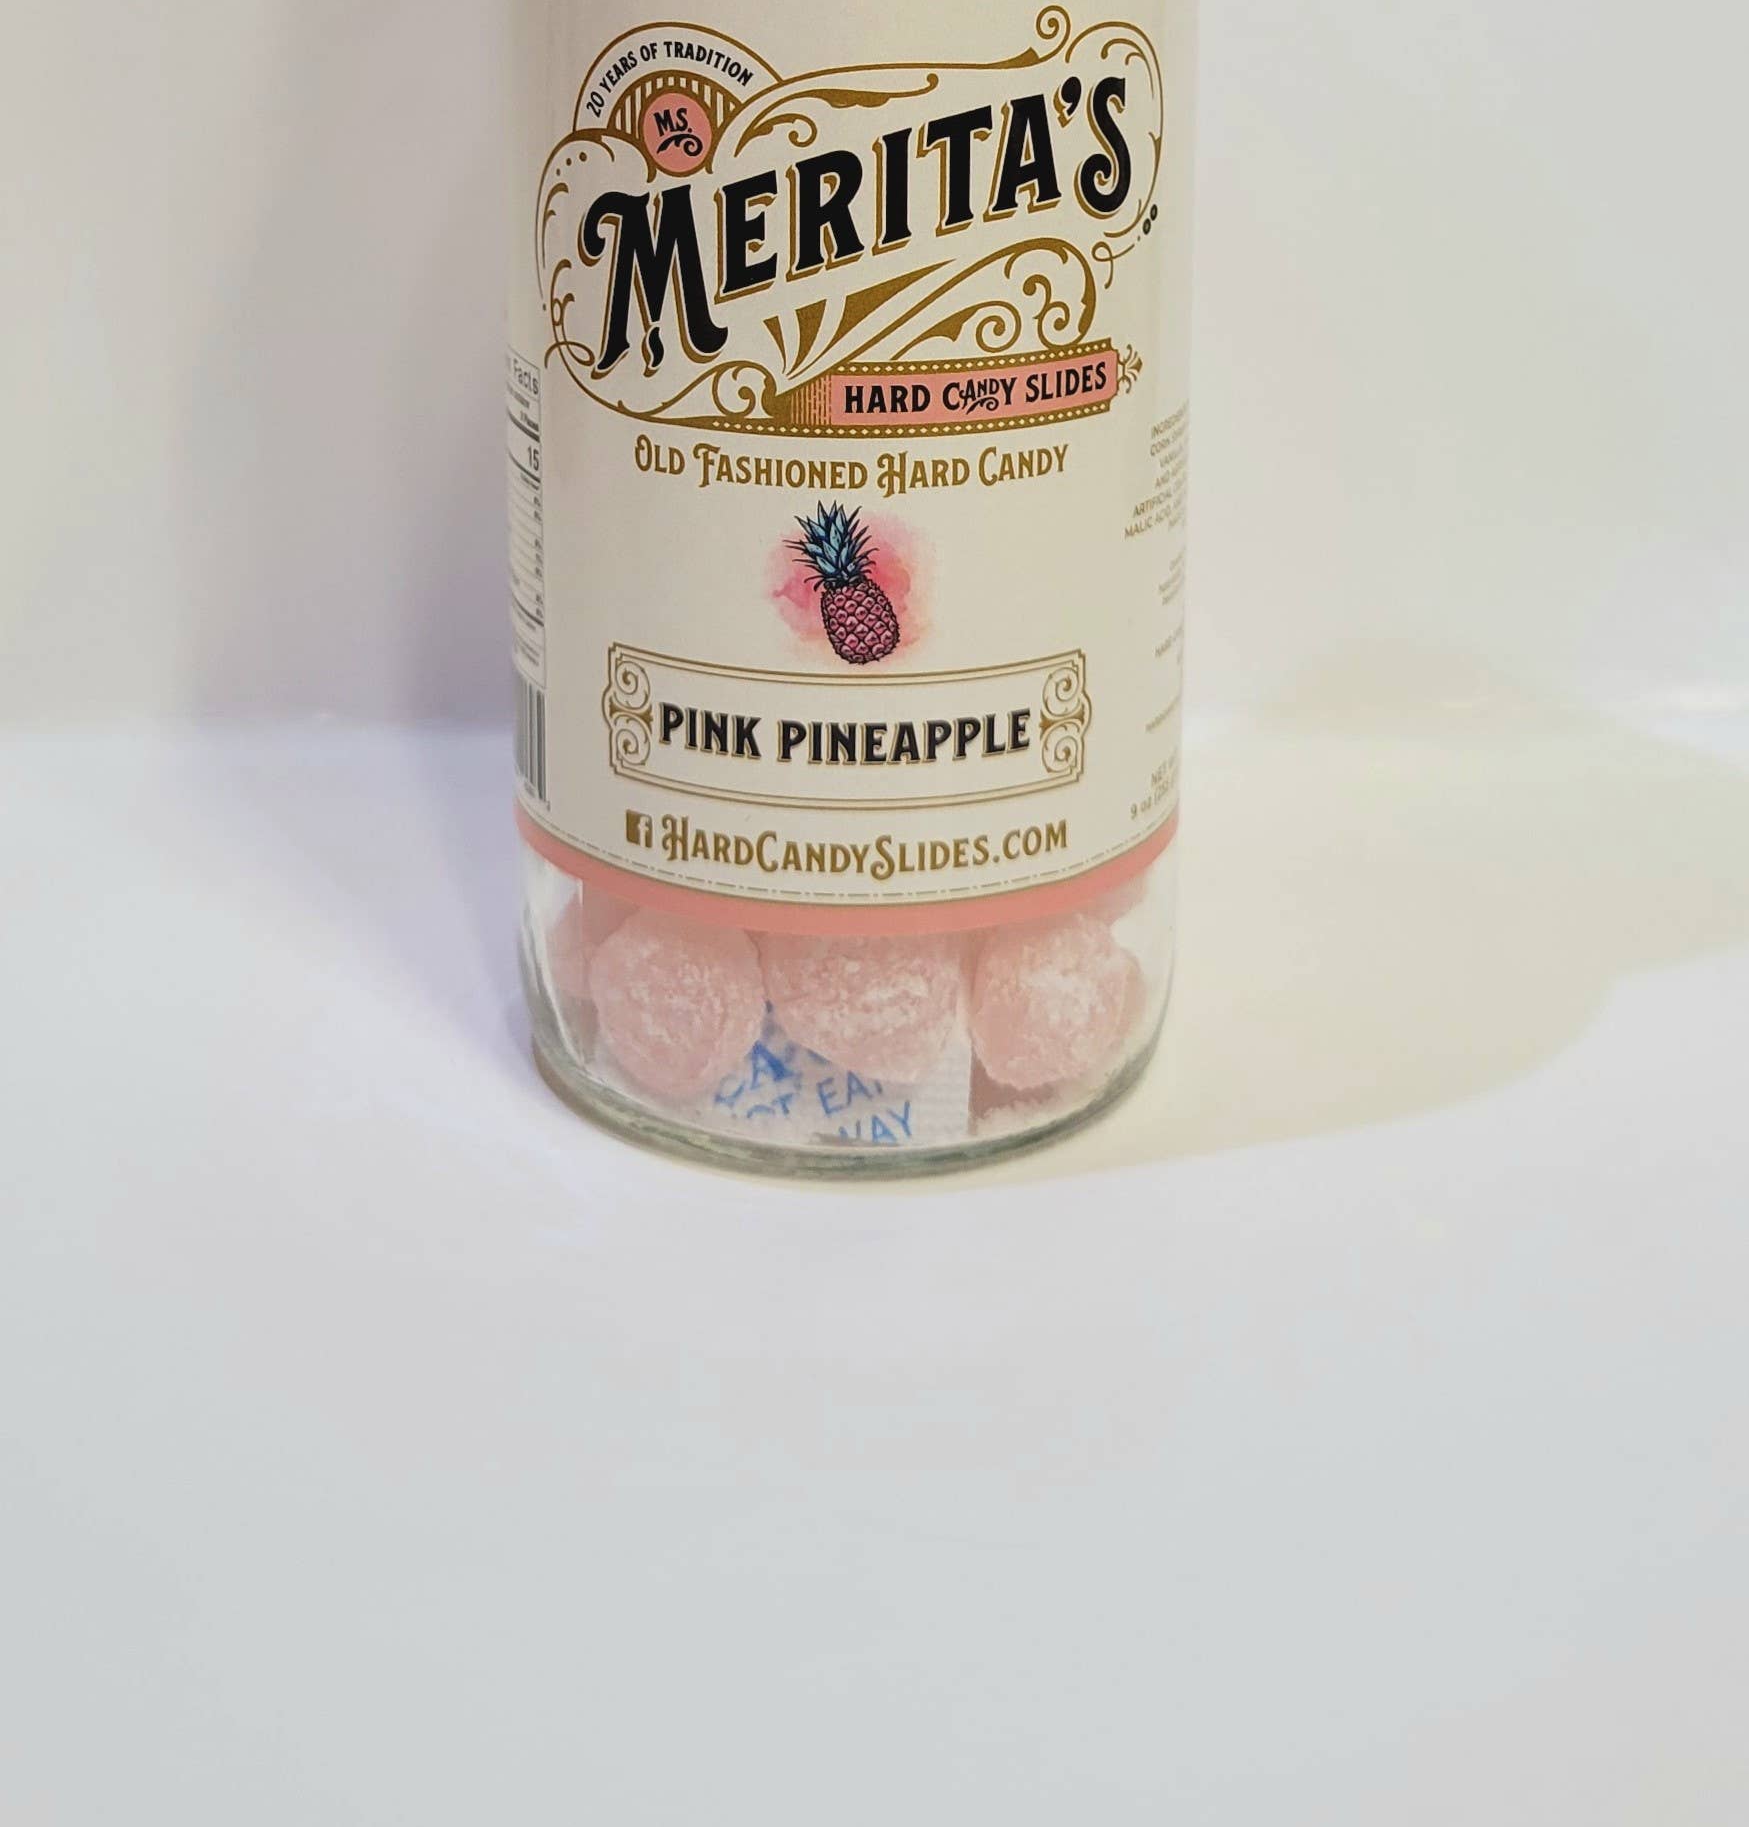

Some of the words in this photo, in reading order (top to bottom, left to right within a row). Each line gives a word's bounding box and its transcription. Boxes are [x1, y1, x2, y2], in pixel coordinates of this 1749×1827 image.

[586, 91, 605, 118] 20
[599, 51, 638, 93] YEARS
[640, 42, 658, 62] OF
[664, 41, 754, 87] TRADITION
[577, 75, 1134, 379] MERITA'S
[844, 384, 931, 413] HARD
[942, 377, 1018, 415] CANDY
[1025, 361, 1107, 403] SLIDES
[634, 434, 686, 474] OLD
[693, 442, 868, 490] FASHIONED
[876, 450, 970, 498] HARD
[978, 444, 1069, 486] CANDY
[659, 701, 761, 759] PINK
[776, 707, 1031, 765] PINEAPPLE
